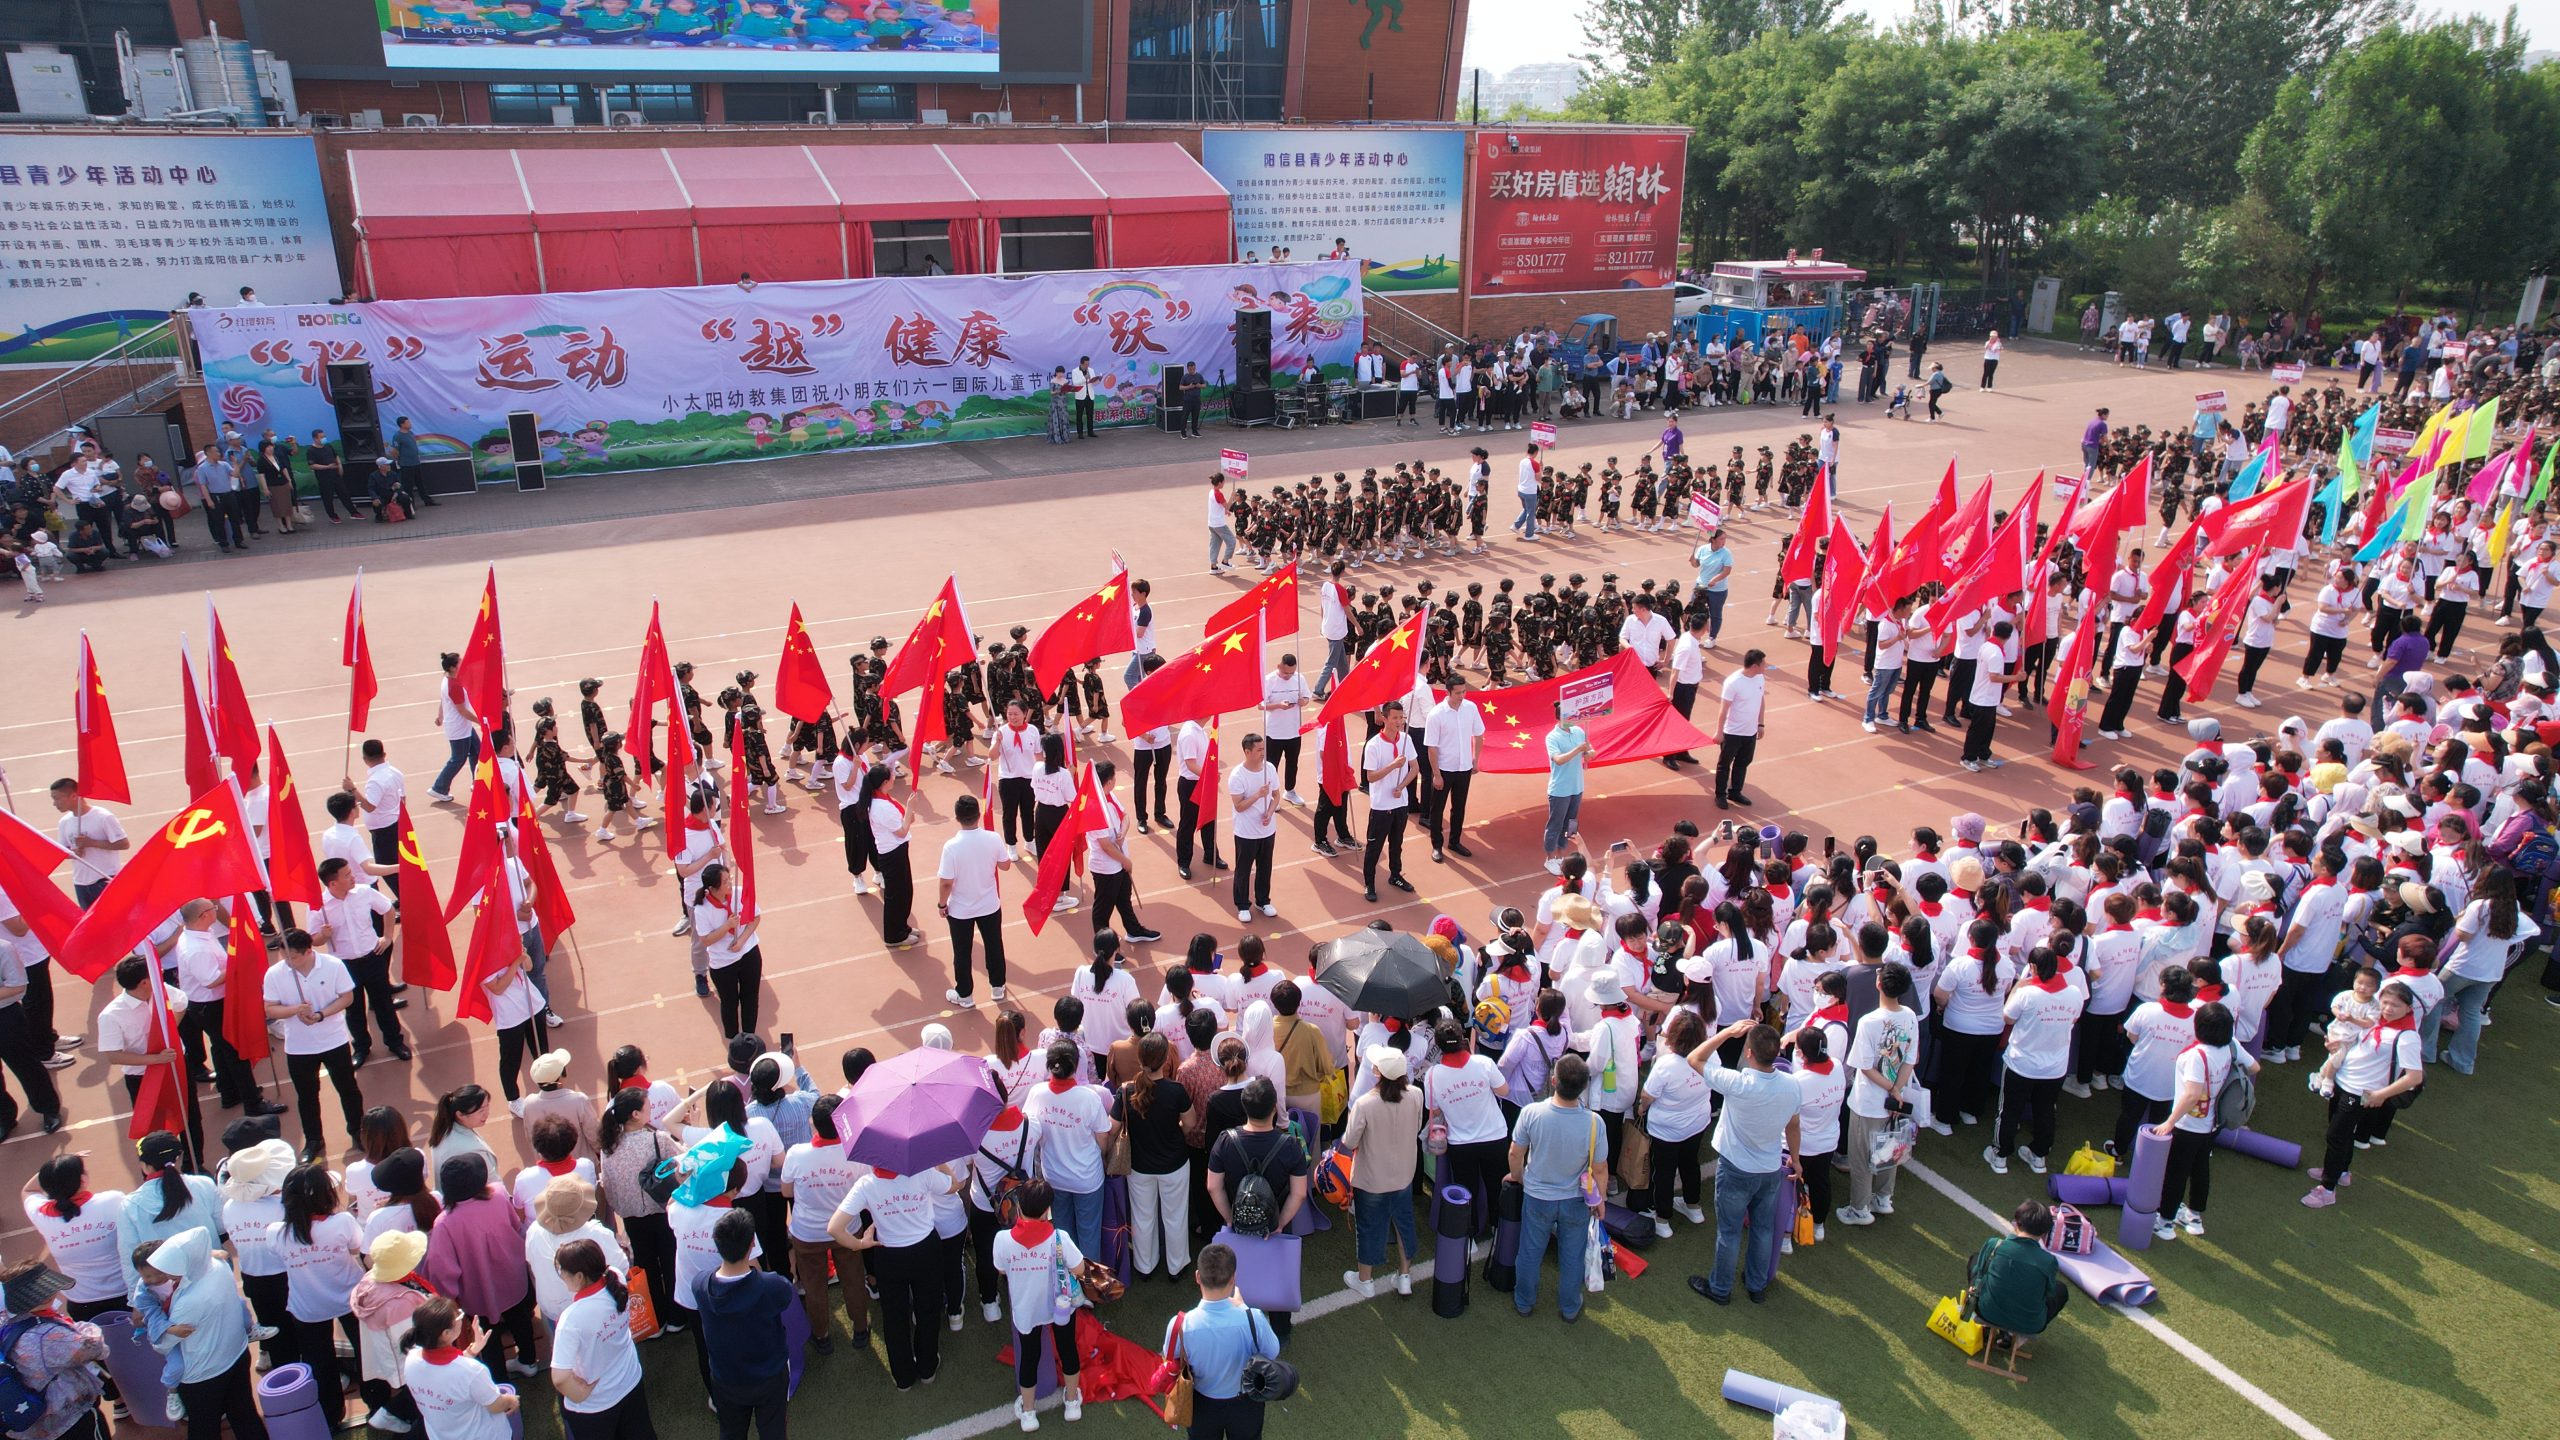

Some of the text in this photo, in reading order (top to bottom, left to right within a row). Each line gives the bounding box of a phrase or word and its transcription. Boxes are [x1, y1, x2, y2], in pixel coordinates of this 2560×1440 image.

[451, 27, 507, 36] 60FPS
[1264, 152, 1408, 168] 阳信县青少年活动中心
[0, 163, 218, 187] 县青少年活动中心
[1489, 161, 1671, 206] 买好房值选翰林
[1516, 253, 1567, 267] 8501777
[1608, 250, 1655, 264] 8211777
[475, 326, 630, 394] 运动
[700, 313, 844, 377] “越”
[883, 309, 1013, 371] 健康
[1072, 300, 1193, 357] “跃”
